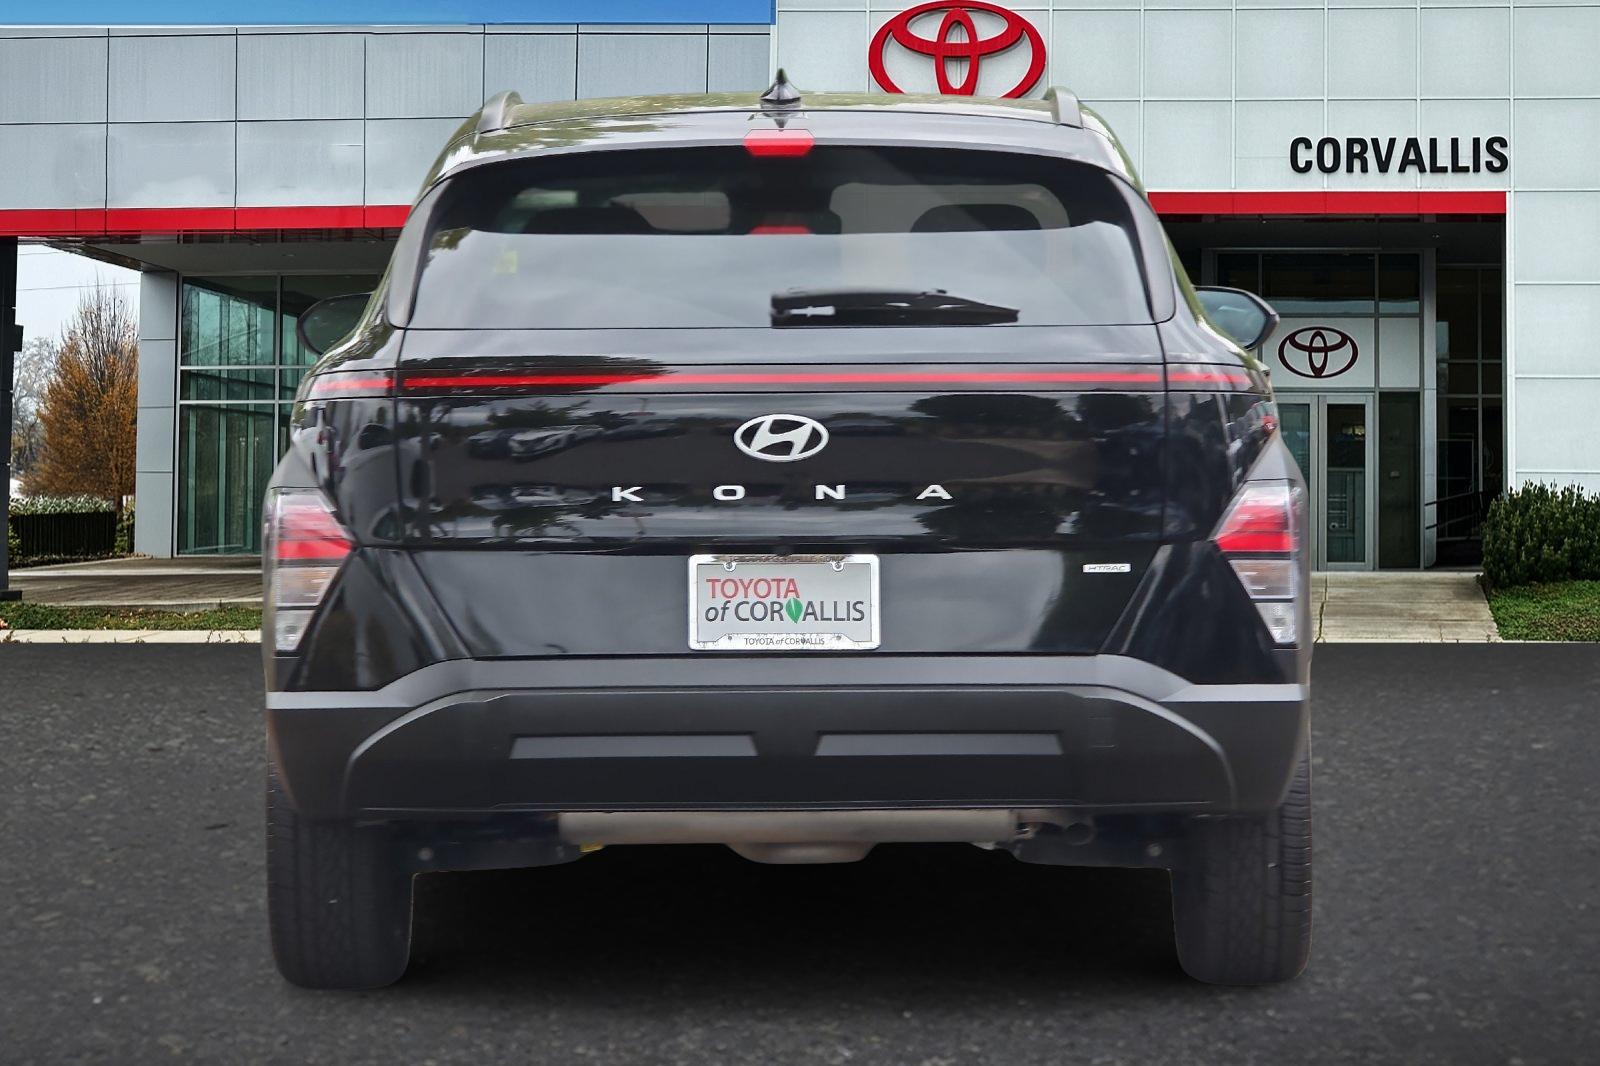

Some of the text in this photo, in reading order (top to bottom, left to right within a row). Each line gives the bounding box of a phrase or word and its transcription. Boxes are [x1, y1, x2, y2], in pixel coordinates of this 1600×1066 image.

[1290, 136, 1509, 174] CORVALLIS
[611, 484, 953, 502] KONA
[706, 578, 800, 598] TOYOTA
[705, 600, 731, 622] of
[744, 637, 775, 646] TOYOTA
[774, 637, 785, 646] of
